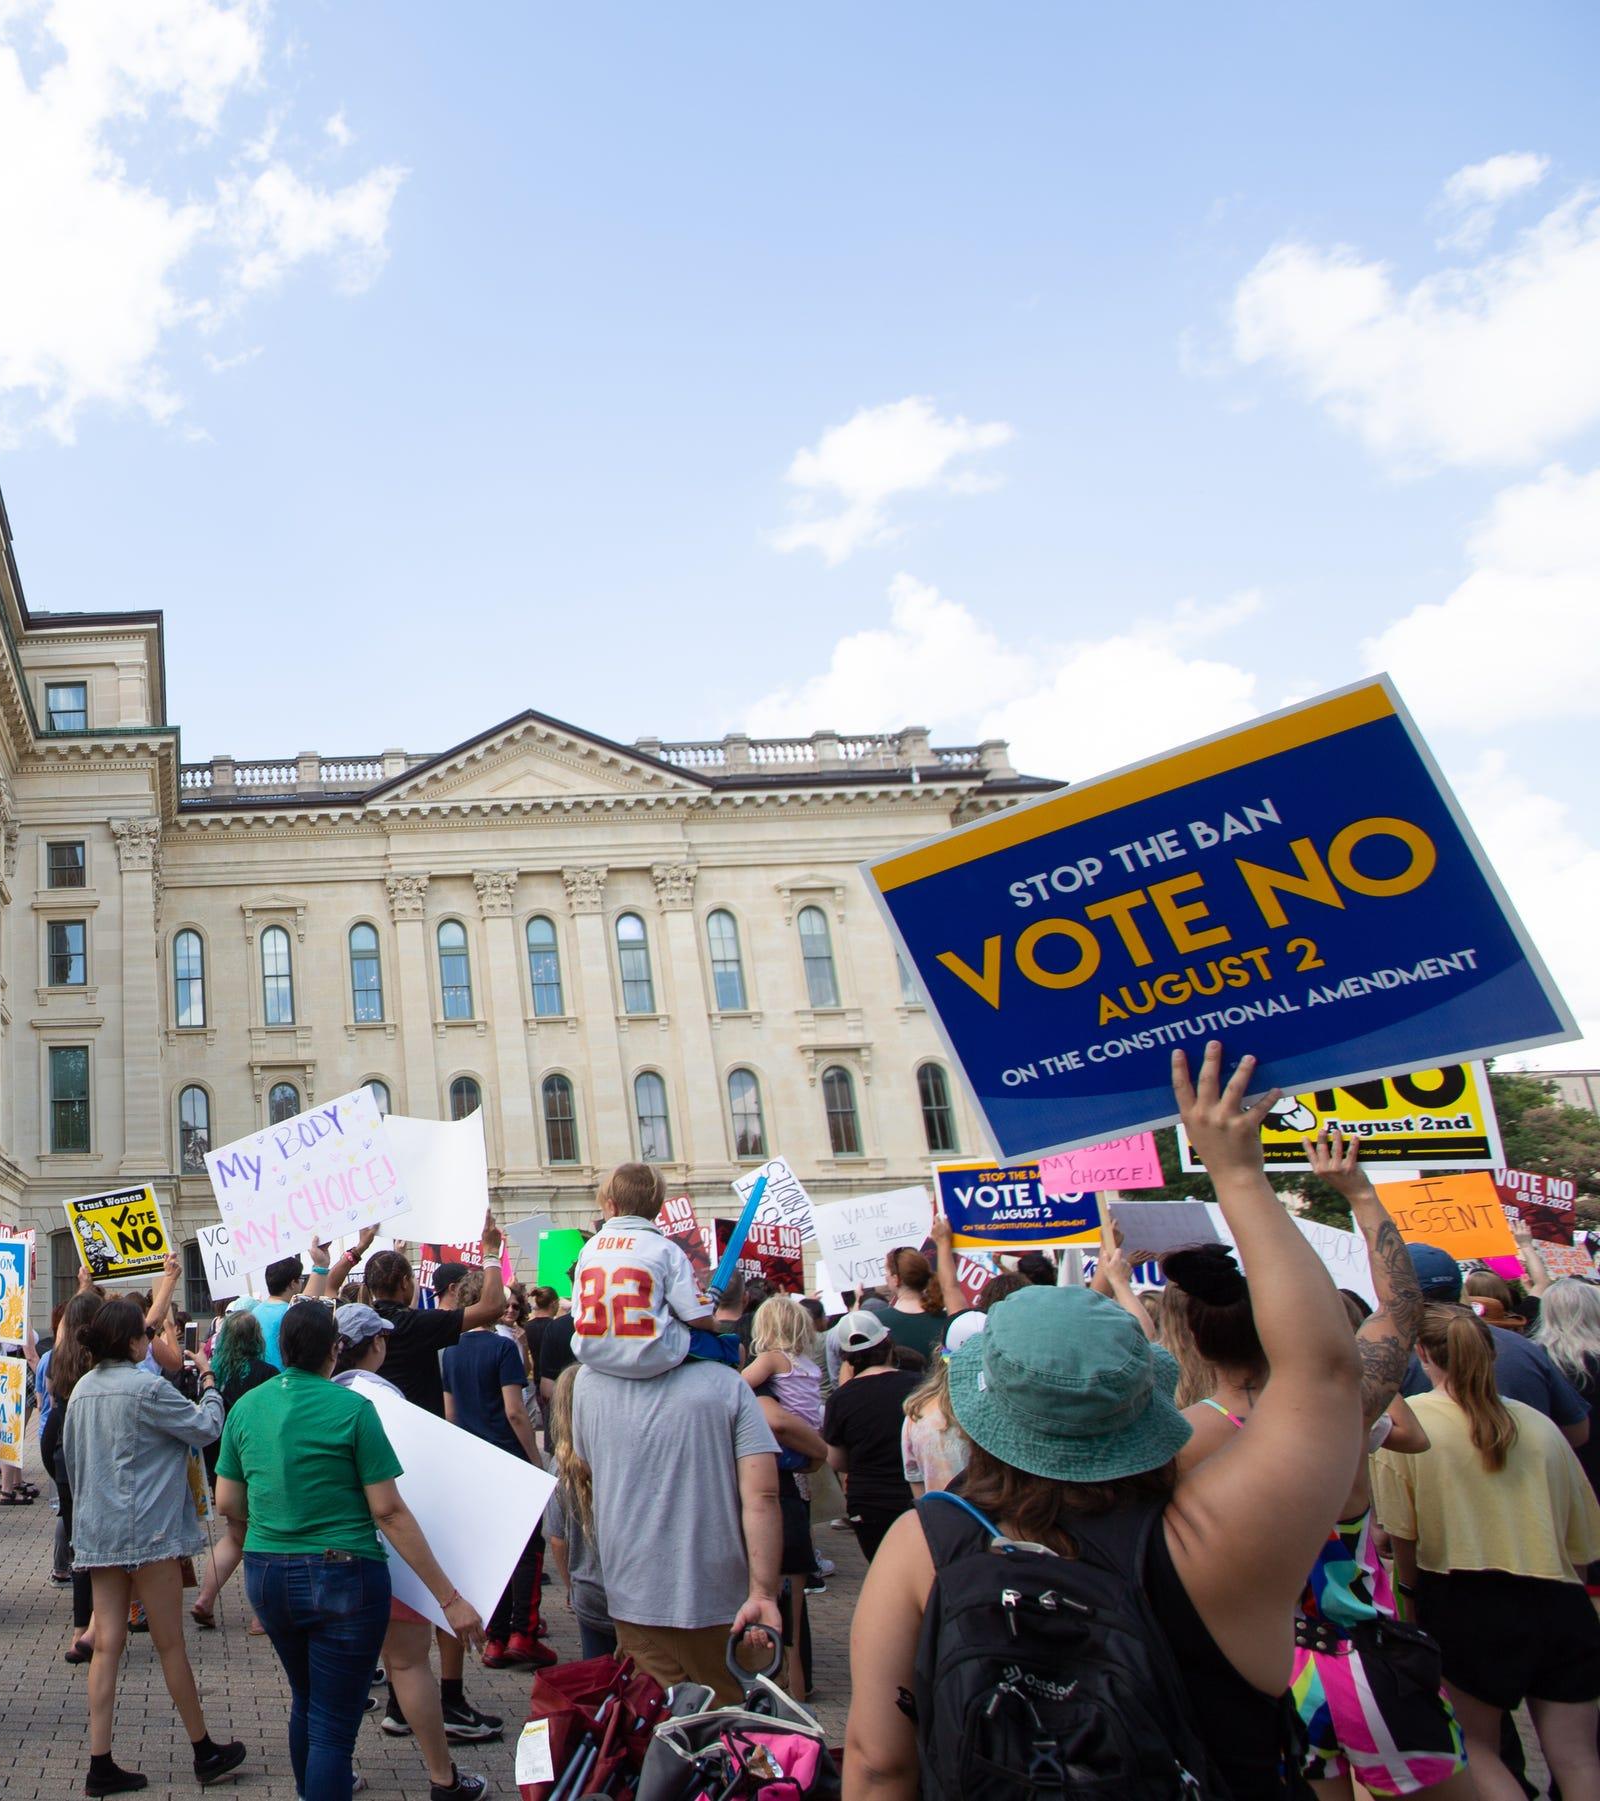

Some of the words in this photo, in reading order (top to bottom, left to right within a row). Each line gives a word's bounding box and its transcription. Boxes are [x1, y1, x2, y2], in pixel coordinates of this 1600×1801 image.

[1009, 859, 1102, 908] STOP
[1110, 829, 1187, 876] THE
[1187, 798, 1283, 848] BAN
[936, 872, 1233, 1010] VOTE
[1236, 817, 1437, 929] NO
[1099, 946, 1273, 1027] AUGUST
[1286, 937, 1327, 973] 2
[1001, 1065, 1037, 1088] ON
[1038, 1050, 1086, 1078] THE
[1087, 997, 1301, 1063] CONSTITUTIONAL
[1307, 948, 1478, 1009] AMENDMENT
[273, 1105, 344, 1160] BODY
[1326, 1119, 1414, 1136] August
[1421, 1115, 1472, 1130] 2nd
[1042, 1155, 1076, 1171] MY
[1070, 1162, 1153, 1185] CHOICE!
[978, 1171, 1006, 1183] STOP
[1008, 1170, 1027, 1181] THE
[1493, 1168, 1542, 1194] VOTE
[1546, 1177, 1573, 1200] NO
[78, 1199, 103, 1211] Trust
[105, 1193, 143, 1206] Women
[288, 1153, 397, 1232] CHOICE!
[953, 1183, 1030, 1210] VOTE
[1409, 1181, 1454, 1205] I
[1516, 1190, 1572, 1211] 08.02.2022
[664, 1197, 692, 1221] NO
[841, 1202, 889, 1224] VALUE
[992, 1208, 1041, 1221] AUGUST
[1043, 1208, 1052, 1218] 2
[1392, 1203, 1494, 1233] ISSENT
[202, 1225, 229, 1248] VO
[746, 1223, 776, 1245] OTE
[779, 1227, 801, 1249] NO
[876, 1222, 918, 1239] CHOICE
[962, 1224, 972, 1232] ON
[973, 1224, 987, 1232] THE
[987, 1221, 1044, 1231] CONSTITUTIONAL
[1045, 1219, 1087, 1228] AMENDMENT
[117, 1225, 164, 1256] NO
[597, 1237, 637, 1250] BOWE
[757, 1244, 800, 1260] 08.02.2022
[126, 1255, 152, 1265] August
[745, 1259, 761, 1271] FOR
[838, 1257, 886, 1282] VOTE
[575, 1266, 656, 1338] 82
[0, 1375, 8, 1394] 2
